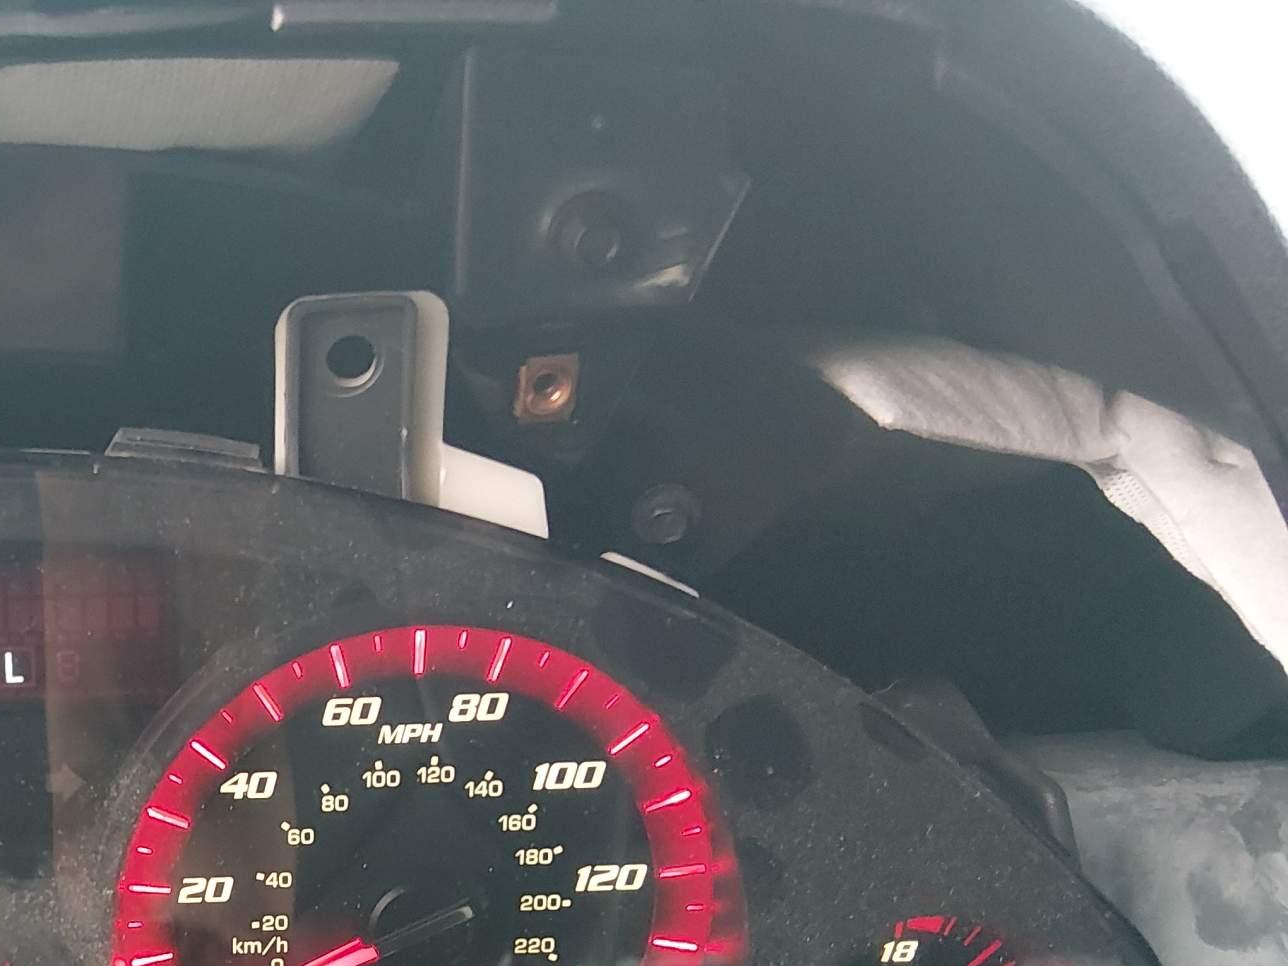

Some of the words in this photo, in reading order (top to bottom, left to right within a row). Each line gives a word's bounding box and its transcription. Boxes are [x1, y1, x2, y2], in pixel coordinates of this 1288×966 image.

[3, 651, 25, 684] L
[321, 696, 382, 727] 60
[448, 692, 510, 723] 80
[377, 722, 443, 745] MPH
[361, 769, 402, 788] 100
[416, 765, 456, 785] 120
[532, 760, 607, 791] 100
[219, 771, 278, 800] 40
[464, 779, 504, 799] 140
[321, 794, 350, 812] 80
[497, 813, 537, 832] 160
[286, 827, 316, 846] 60
[515, 848, 553, 866] 180
[265, 871, 293, 889] 40
[575, 863, 648, 892] 120
[177, 876, 234, 904] 20
[519, 894, 561, 912] 200
[262, 914, 289, 932] 20
[232, 936, 289, 956] km/h
[514, 937, 556, 956] 220
[880, 940, 920, 964] 18
